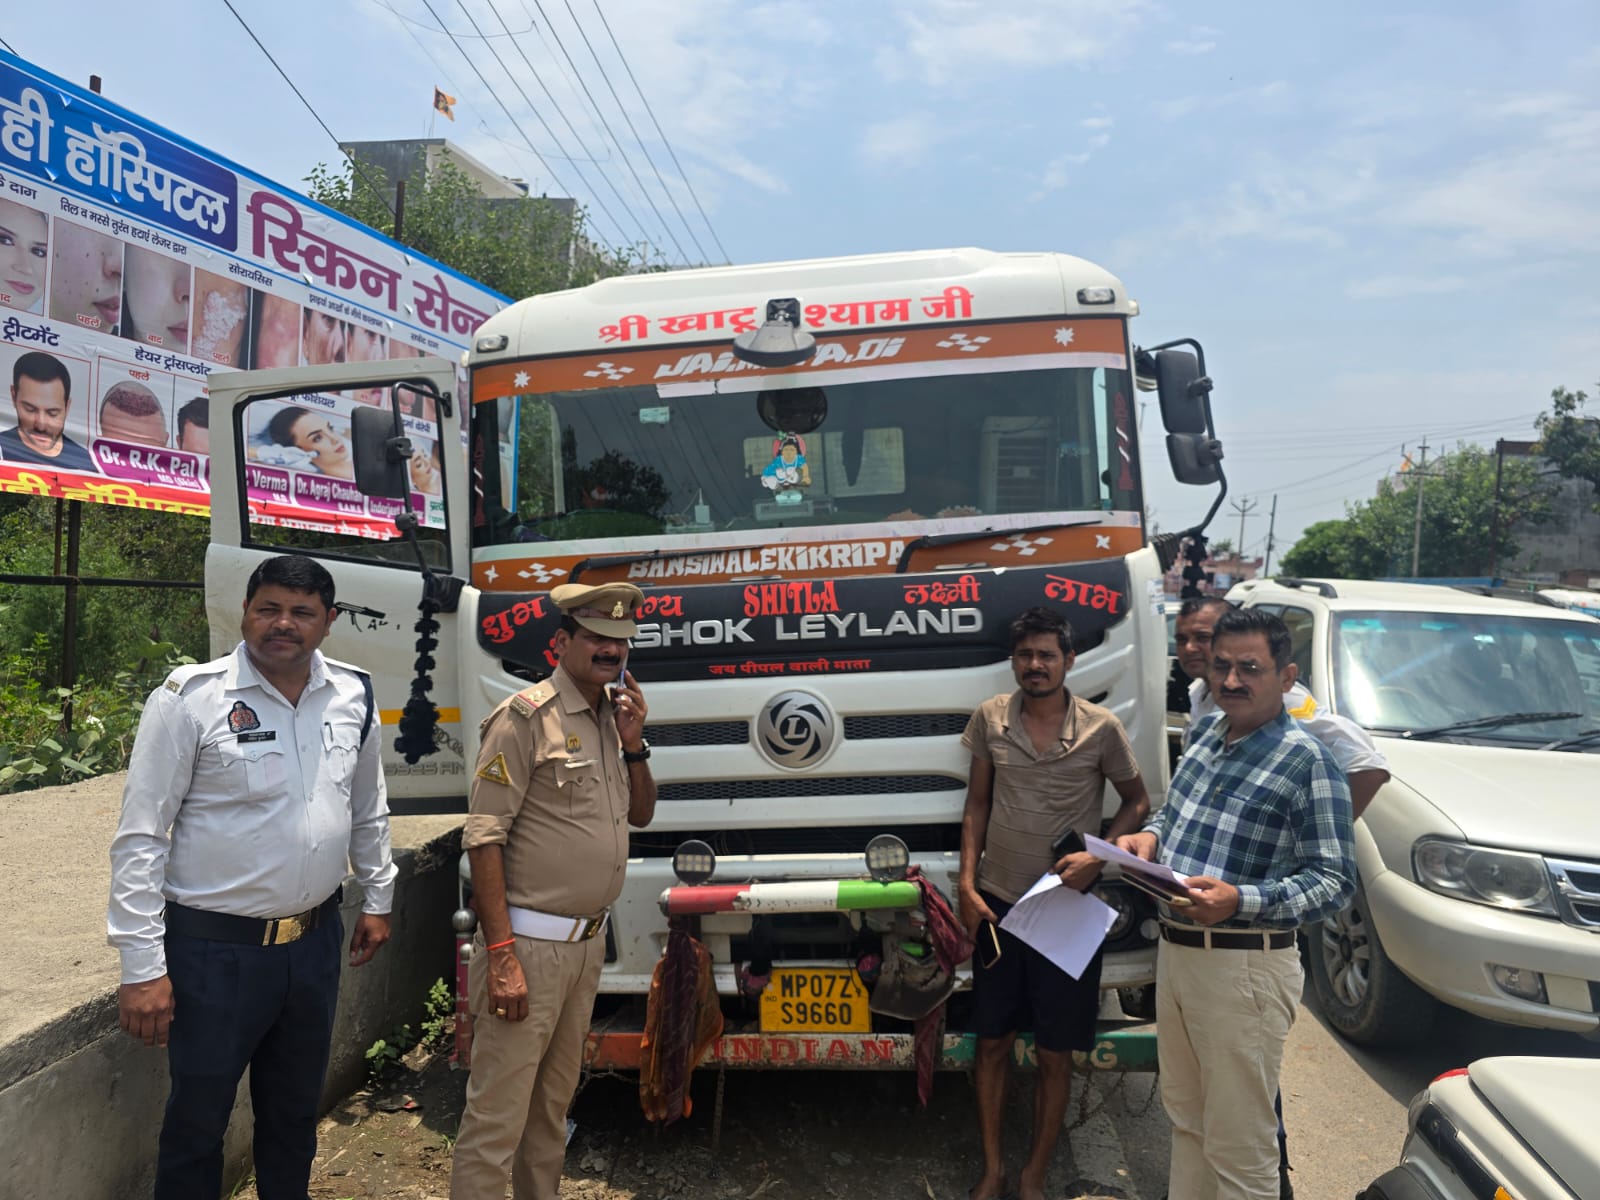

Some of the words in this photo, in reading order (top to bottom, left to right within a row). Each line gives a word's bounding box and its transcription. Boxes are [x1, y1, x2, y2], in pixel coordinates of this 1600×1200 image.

[9, 180, 37, 200] दाग
[64, 122, 230, 234] हॉस्पिटल
[60, 197, 79, 215] तिल
[81, 207, 88, 219] व
[246, 191, 402, 312] स्किन
[229, 263, 273, 287] सोरायसिस
[598, 315, 651, 343] श्री
[658, 306, 759, 334] खाटू
[804, 298, 912, 328] श्याम
[920, 286, 974, 319] जी
[2, 317, 60, 347] ट्रीटमेंट
[134, 346, 161, 364] हेयर
[128, 369, 150, 381] पहले
[99, 444, 127, 467] Dr.
[130, 449, 167, 473] R.K.
[170, 456, 195, 478] Pal
[252, 469, 287, 492] Verma
[297, 477, 309, 495] Dr.
[310, 479, 331, 502] Agraj
[744, 580, 840, 617] SHITLA
[904, 575, 981, 605] लक्ष्मी
[1044, 574, 1122, 614] लाभ
[481, 596, 547, 643] शुभ
[627, 618, 754, 649] SHOK
[776, 607, 982, 640] LEYLAND
[740, 660, 785, 674] पीपल
[833, 659, 871, 670] माता
[781, 974, 853, 998] MP07Z
[781, 1002, 852, 1025] S9660
[711, 1036, 895, 1064] INDIAN
[1014, 1039, 1118, 1069] KG
